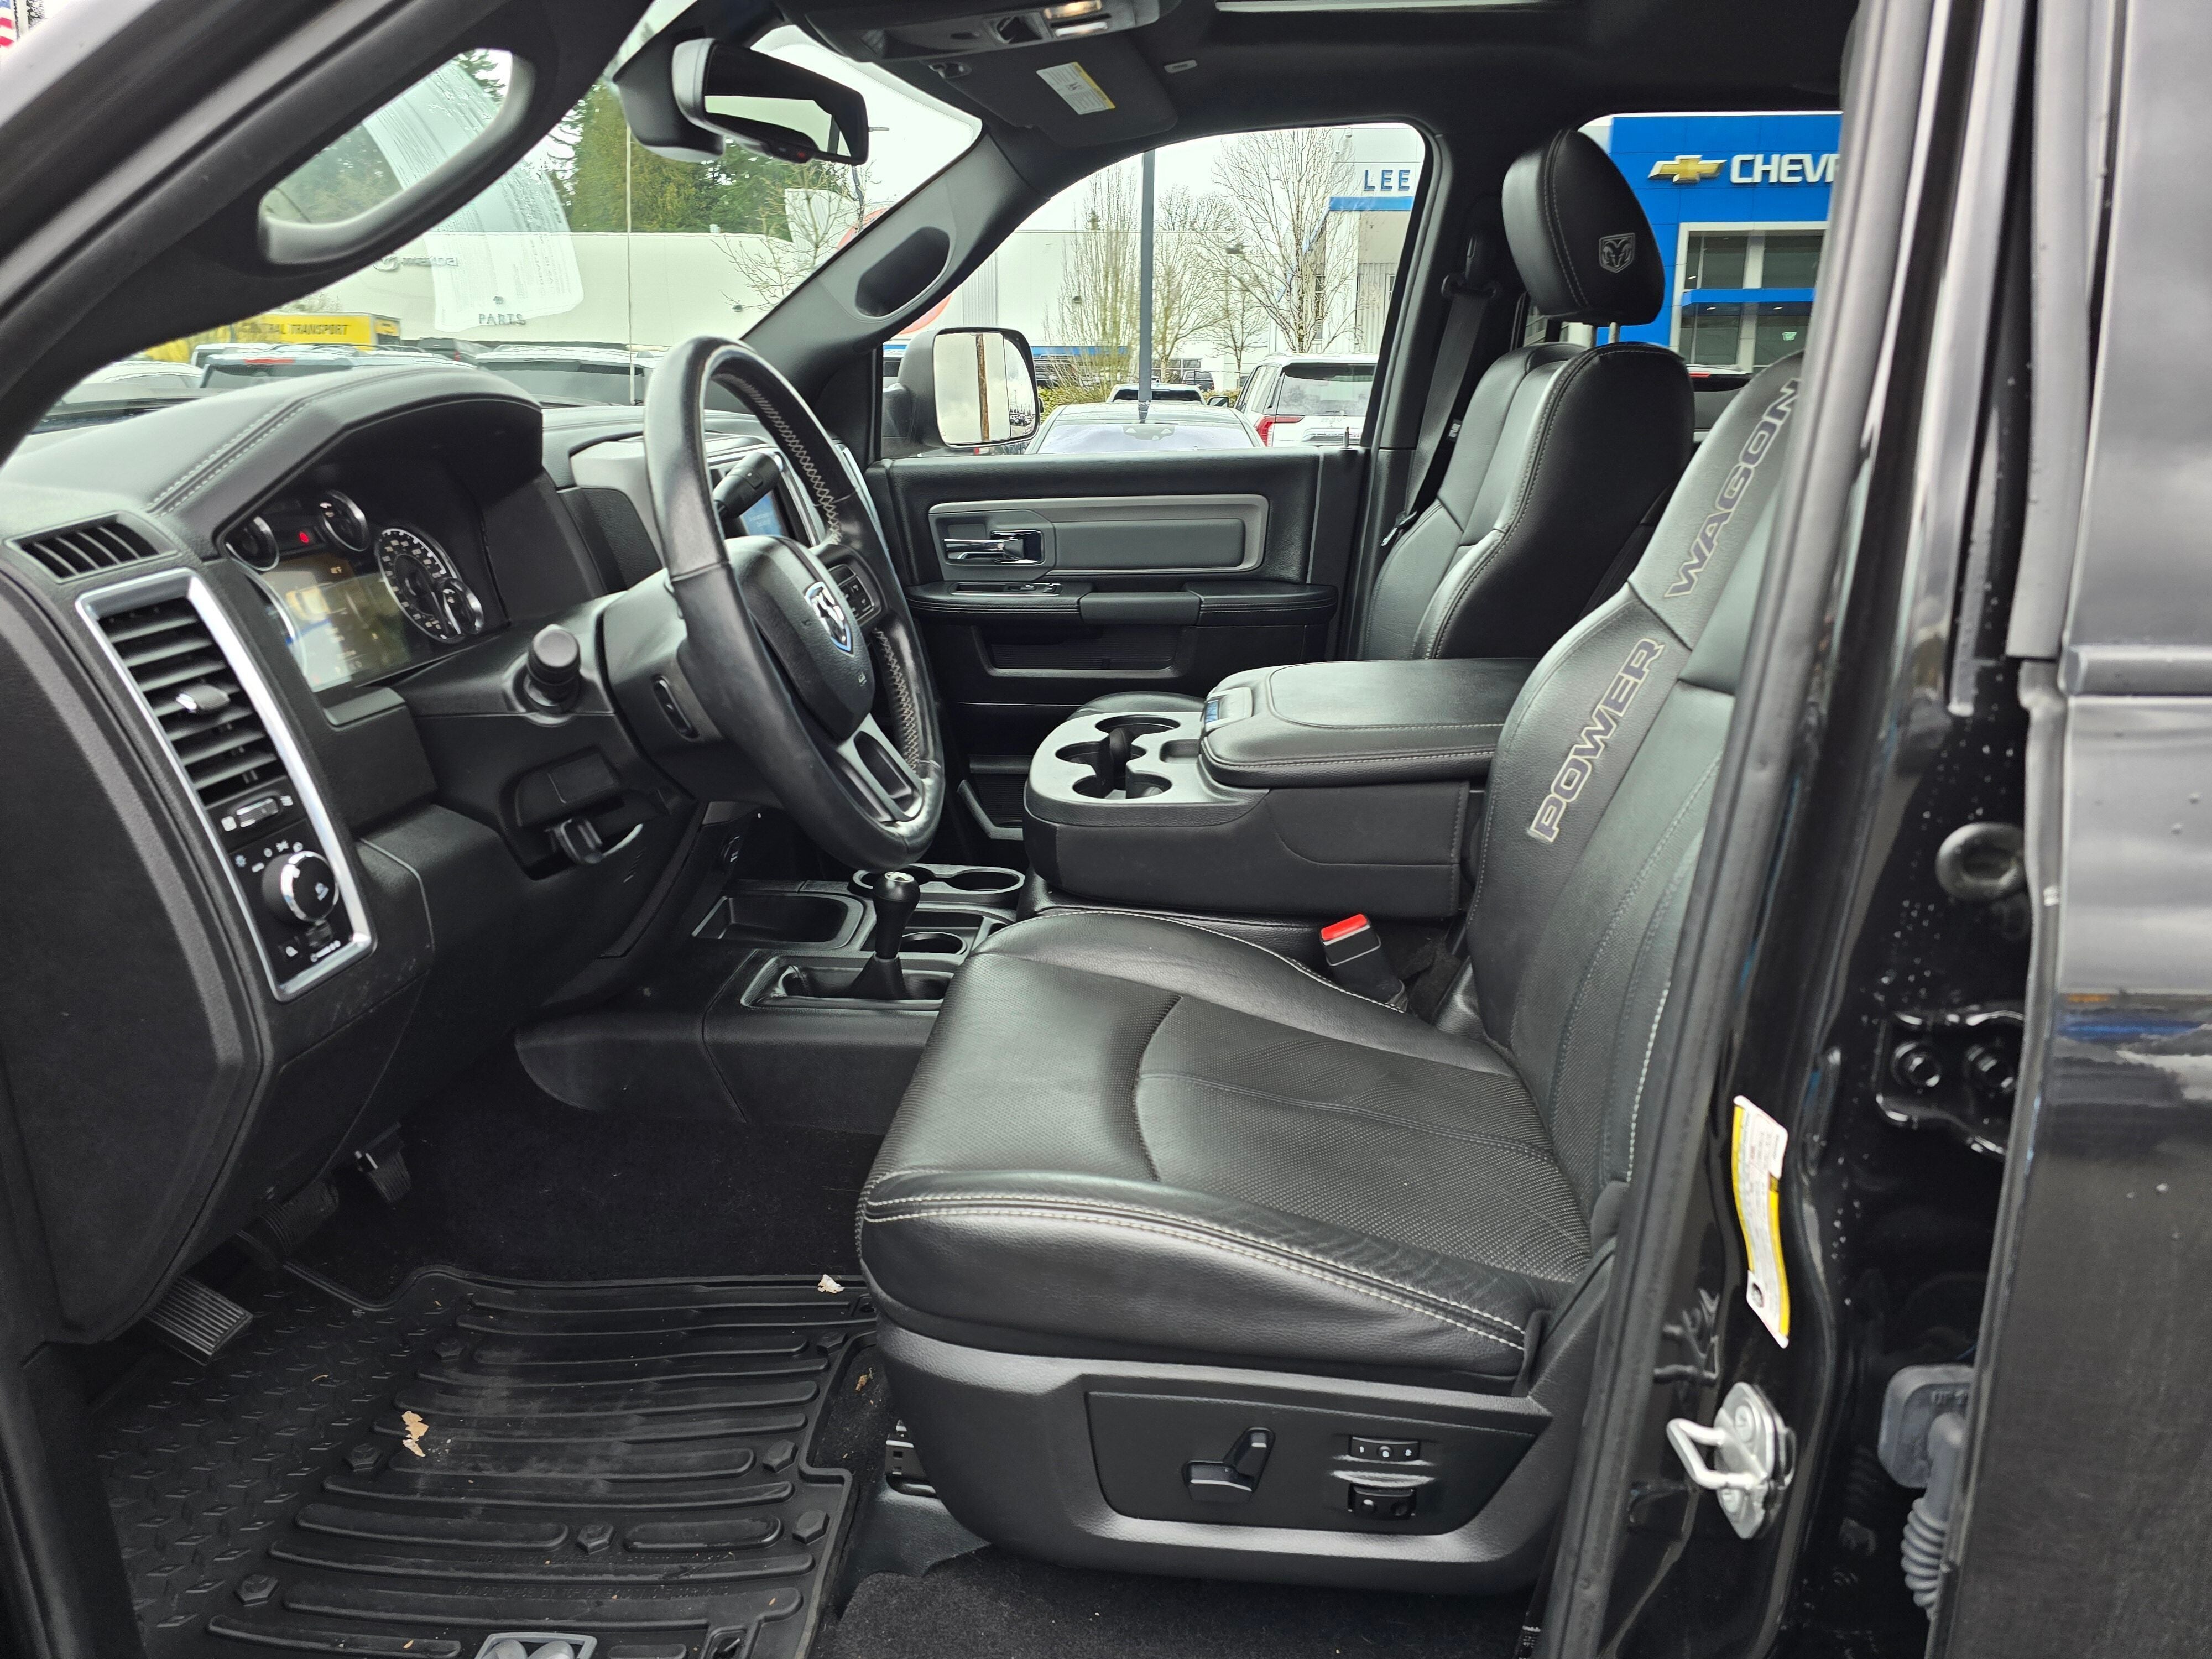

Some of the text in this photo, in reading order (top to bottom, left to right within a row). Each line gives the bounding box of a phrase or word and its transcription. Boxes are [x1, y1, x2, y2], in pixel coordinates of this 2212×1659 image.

[1364, 169, 1411, 191] LEE
[288, 322, 351, 335] TRANSPORT
[478, 314, 526, 325] PARTS
[1663, 378, 1802, 597] WAGON
[1530, 638, 1666, 843] POWER
